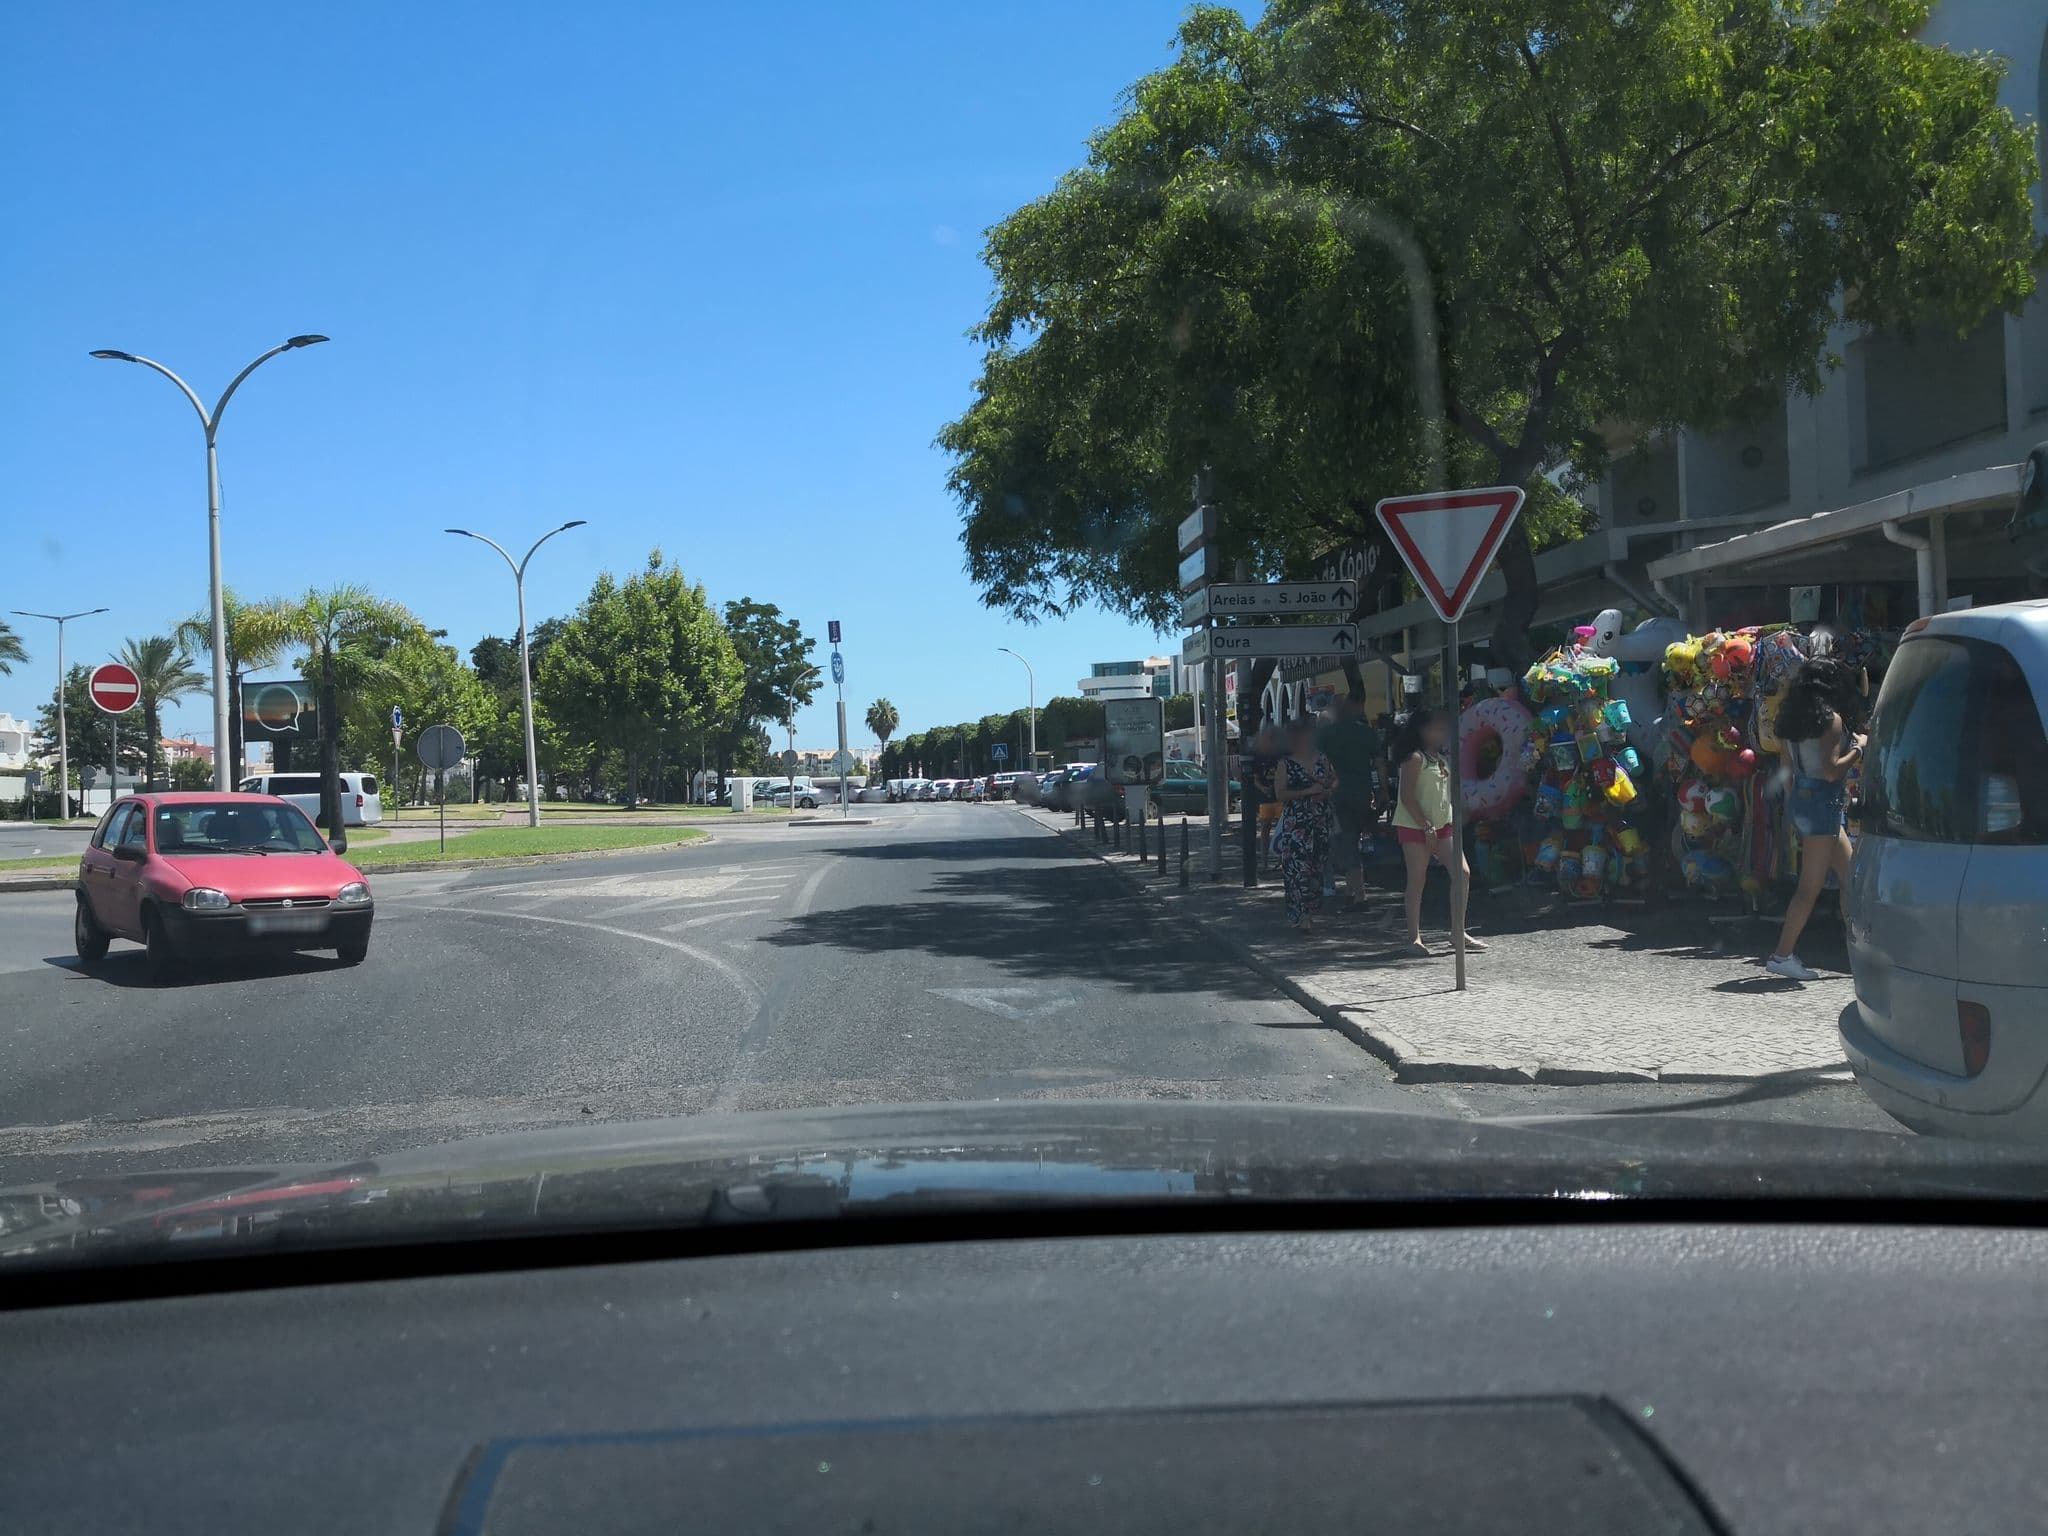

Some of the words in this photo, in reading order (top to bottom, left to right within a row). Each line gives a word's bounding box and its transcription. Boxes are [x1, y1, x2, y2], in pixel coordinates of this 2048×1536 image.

[1213, 593, 1256, 606] Areias
[1279, 592, 1292, 604] S.
[1296, 591, 1326, 604] João
[1214, 636, 1250, 649] Oura
